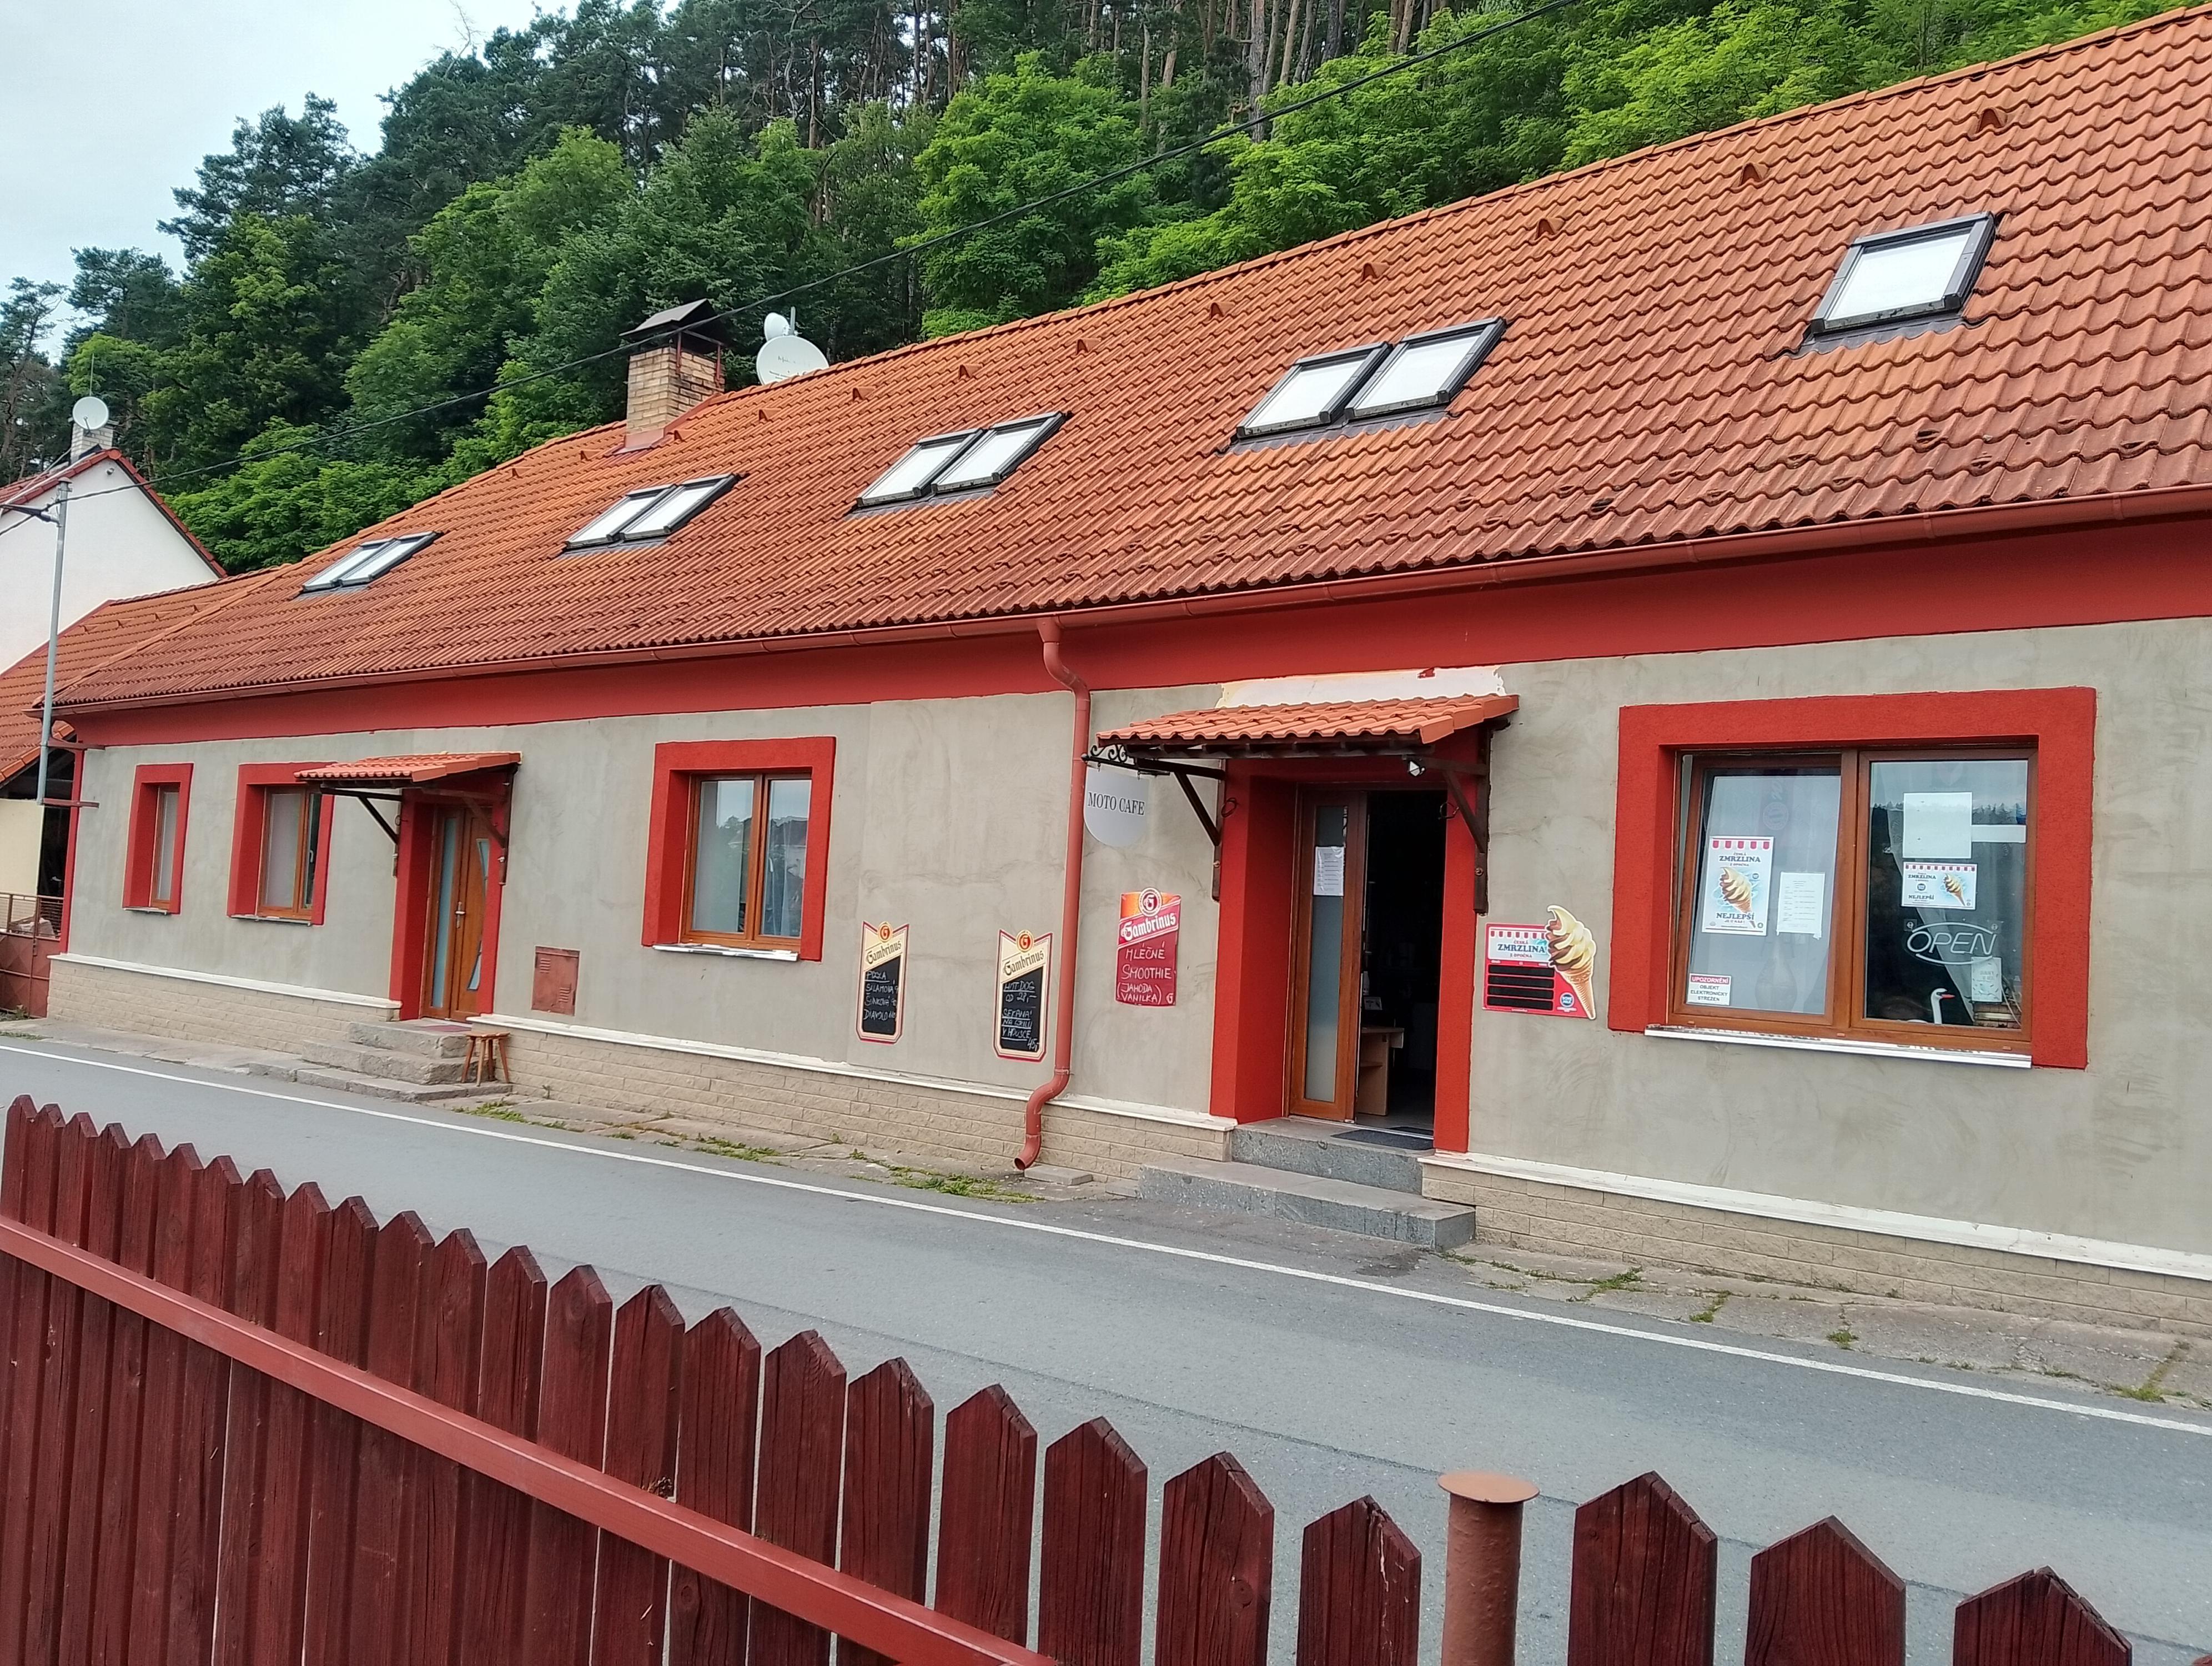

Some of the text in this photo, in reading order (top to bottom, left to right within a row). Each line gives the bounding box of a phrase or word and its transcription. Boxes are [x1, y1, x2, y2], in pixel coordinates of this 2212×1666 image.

[1088, 792, 1145, 815] MOTO CAFE
[1120, 912, 1177, 941] Gambrinus
[866, 940, 902, 965] Gambrinus
[1125, 941, 1165, 961] MLÉČNÉ
[1497, 944, 1545, 953] ZMRZLINA
[1907, 931, 1997, 955] OPEN
[1003, 950, 1044, 976] Gambrinus
[1121, 964, 1172, 980] SMOOTHIE
